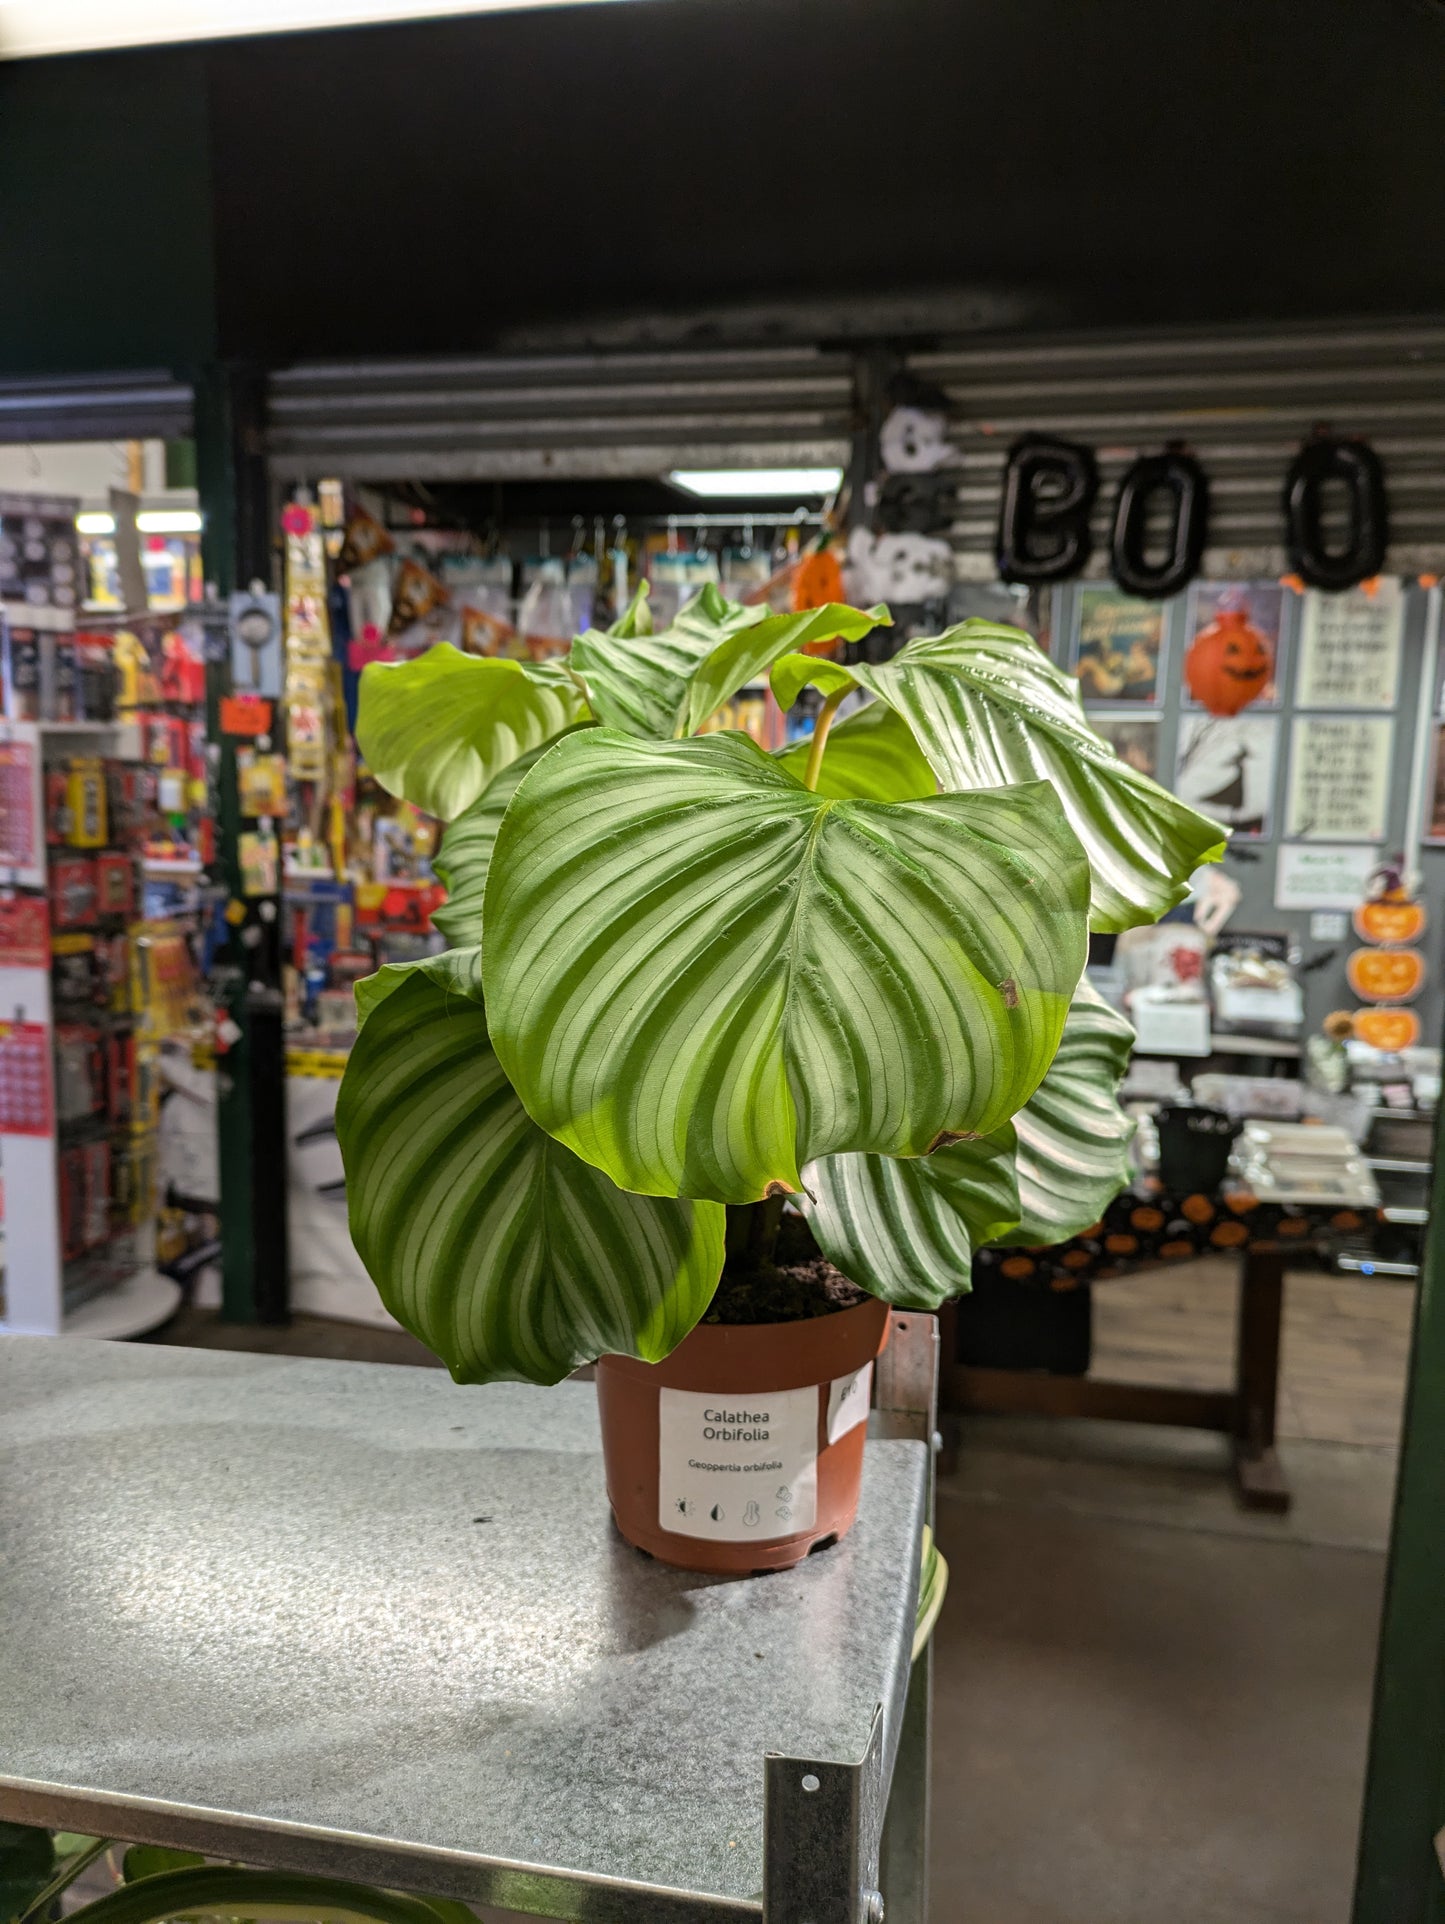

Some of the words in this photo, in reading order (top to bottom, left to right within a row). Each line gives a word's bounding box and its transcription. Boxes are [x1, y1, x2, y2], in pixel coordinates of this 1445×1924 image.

[703, 1409, 770, 1423] Calathea
[703, 1426, 770, 1441] Orbifolia
[688, 1458, 742, 1472] Geoppertia
[743, 1461, 783, 1472] orbifolia
